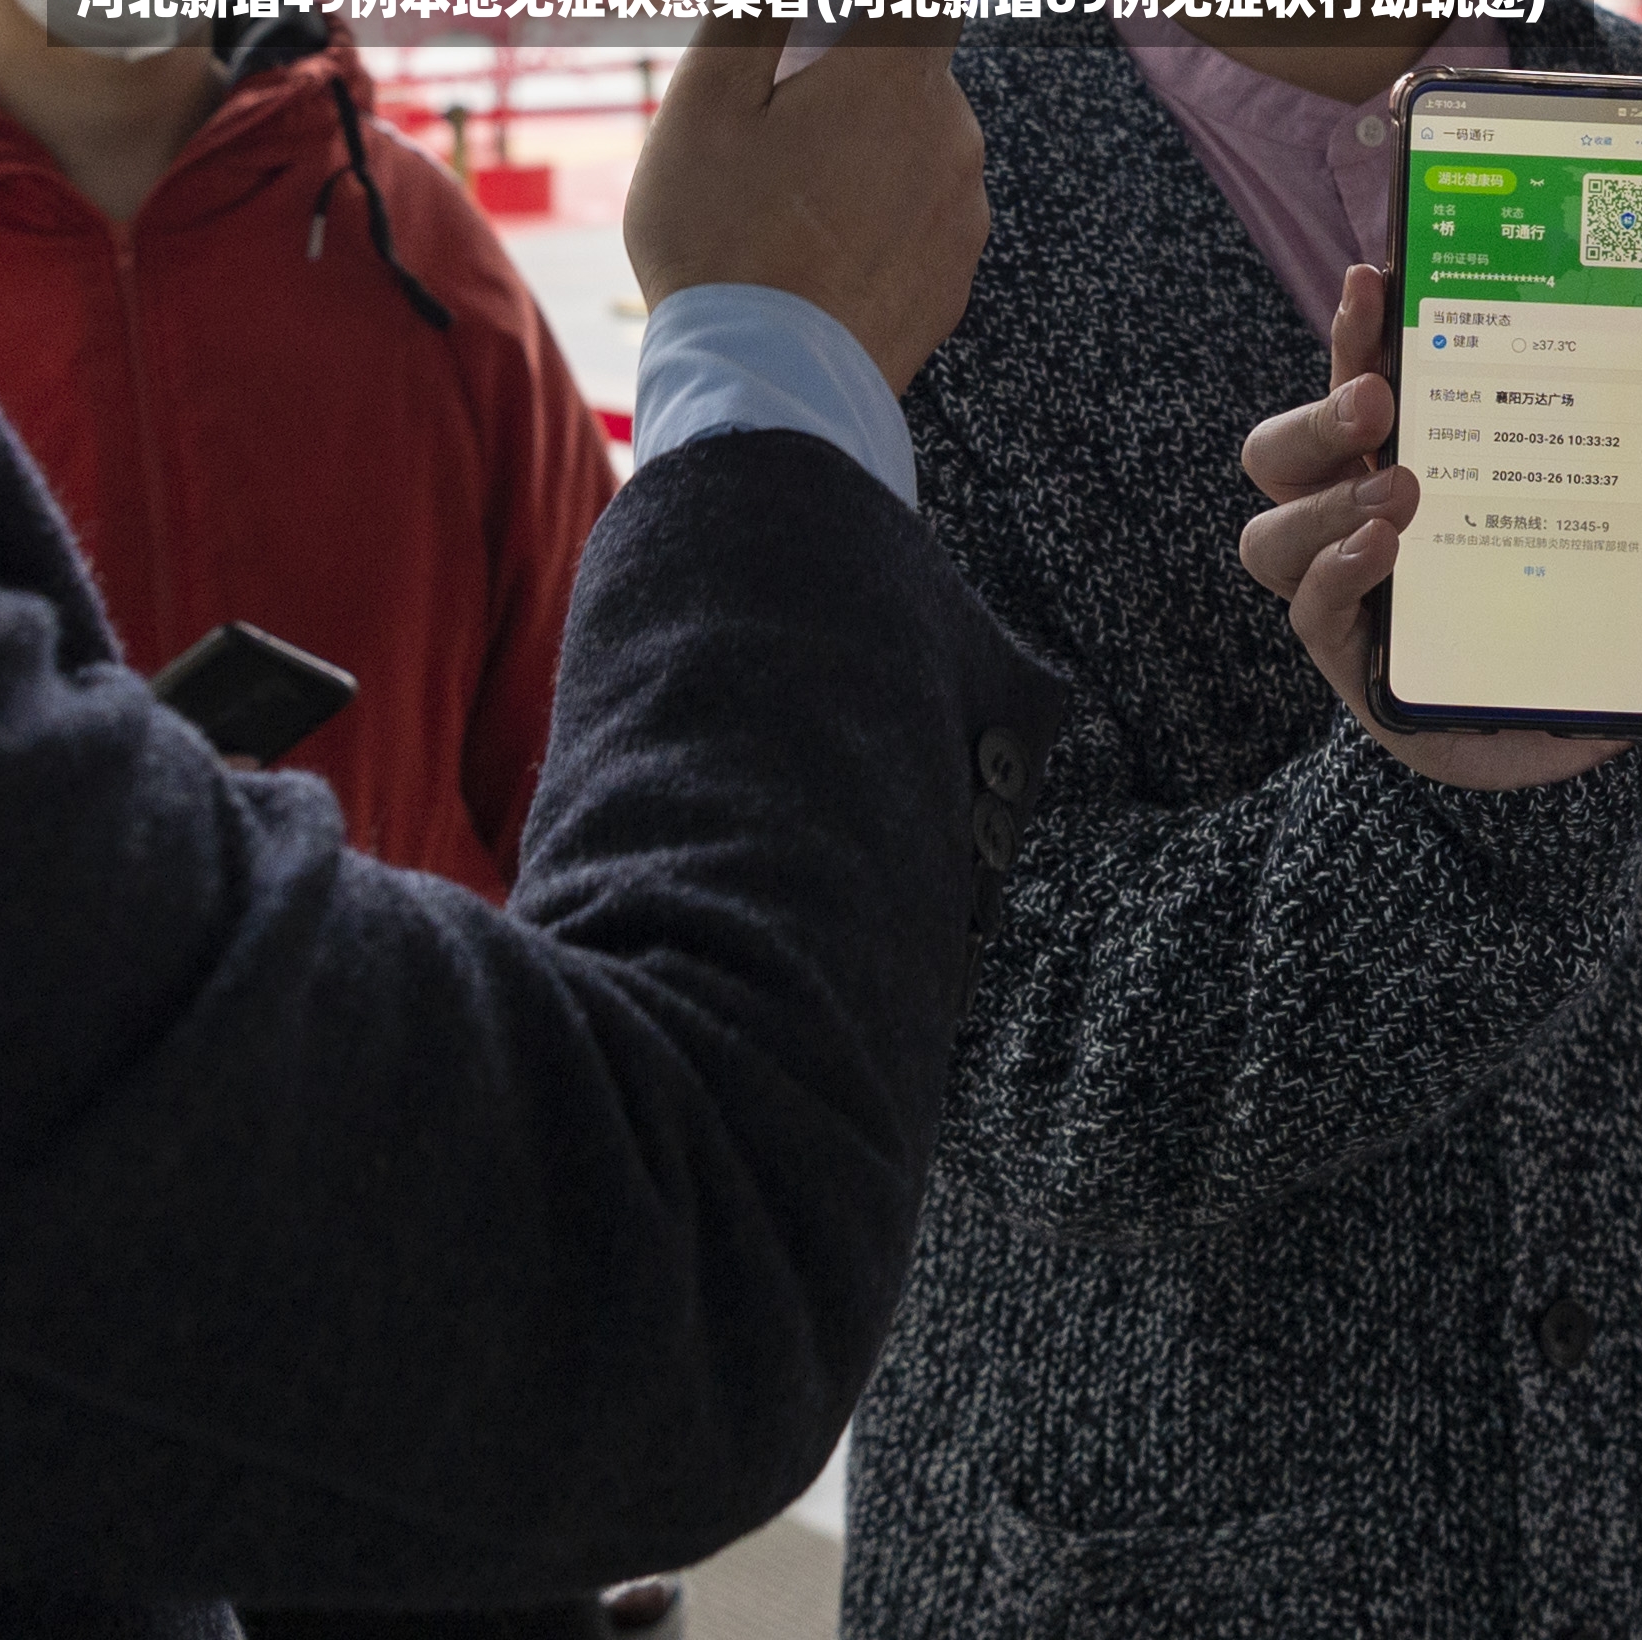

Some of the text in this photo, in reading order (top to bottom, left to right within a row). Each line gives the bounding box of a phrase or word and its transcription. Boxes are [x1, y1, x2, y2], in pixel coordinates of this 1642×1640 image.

[1443, 128, 1495, 143] 一码通行
[1438, 171, 1505, 189] 湖北健康码
[1433, 204, 1456, 217] 姓名
[1501, 206, 1525, 220] 状态
[1501, 224, 1546, 241] 可通行
[1431, 251, 1490, 266] 身份证号码
[1433, 311, 1512, 328] 当前健康状态
[1453, 334, 1479, 348] 健康
[1429, 388, 1482, 403] 核验地点
[1495, 391, 1575, 407] 襄阳万达广场
[1428, 428, 1481, 443] 扫码时间
[1493, 431, 1620, 448] 2020-03-26 10:33:32
[1426, 466, 1479, 482] 进入时间
[1492, 470, 1619, 486] 2020-03-26 10:33:37
[1432, 533, 1640, 553] 本服务由湖北省新冠肺炎防控指挥部提供
[1524, 566, 1546, 577] 申诉
